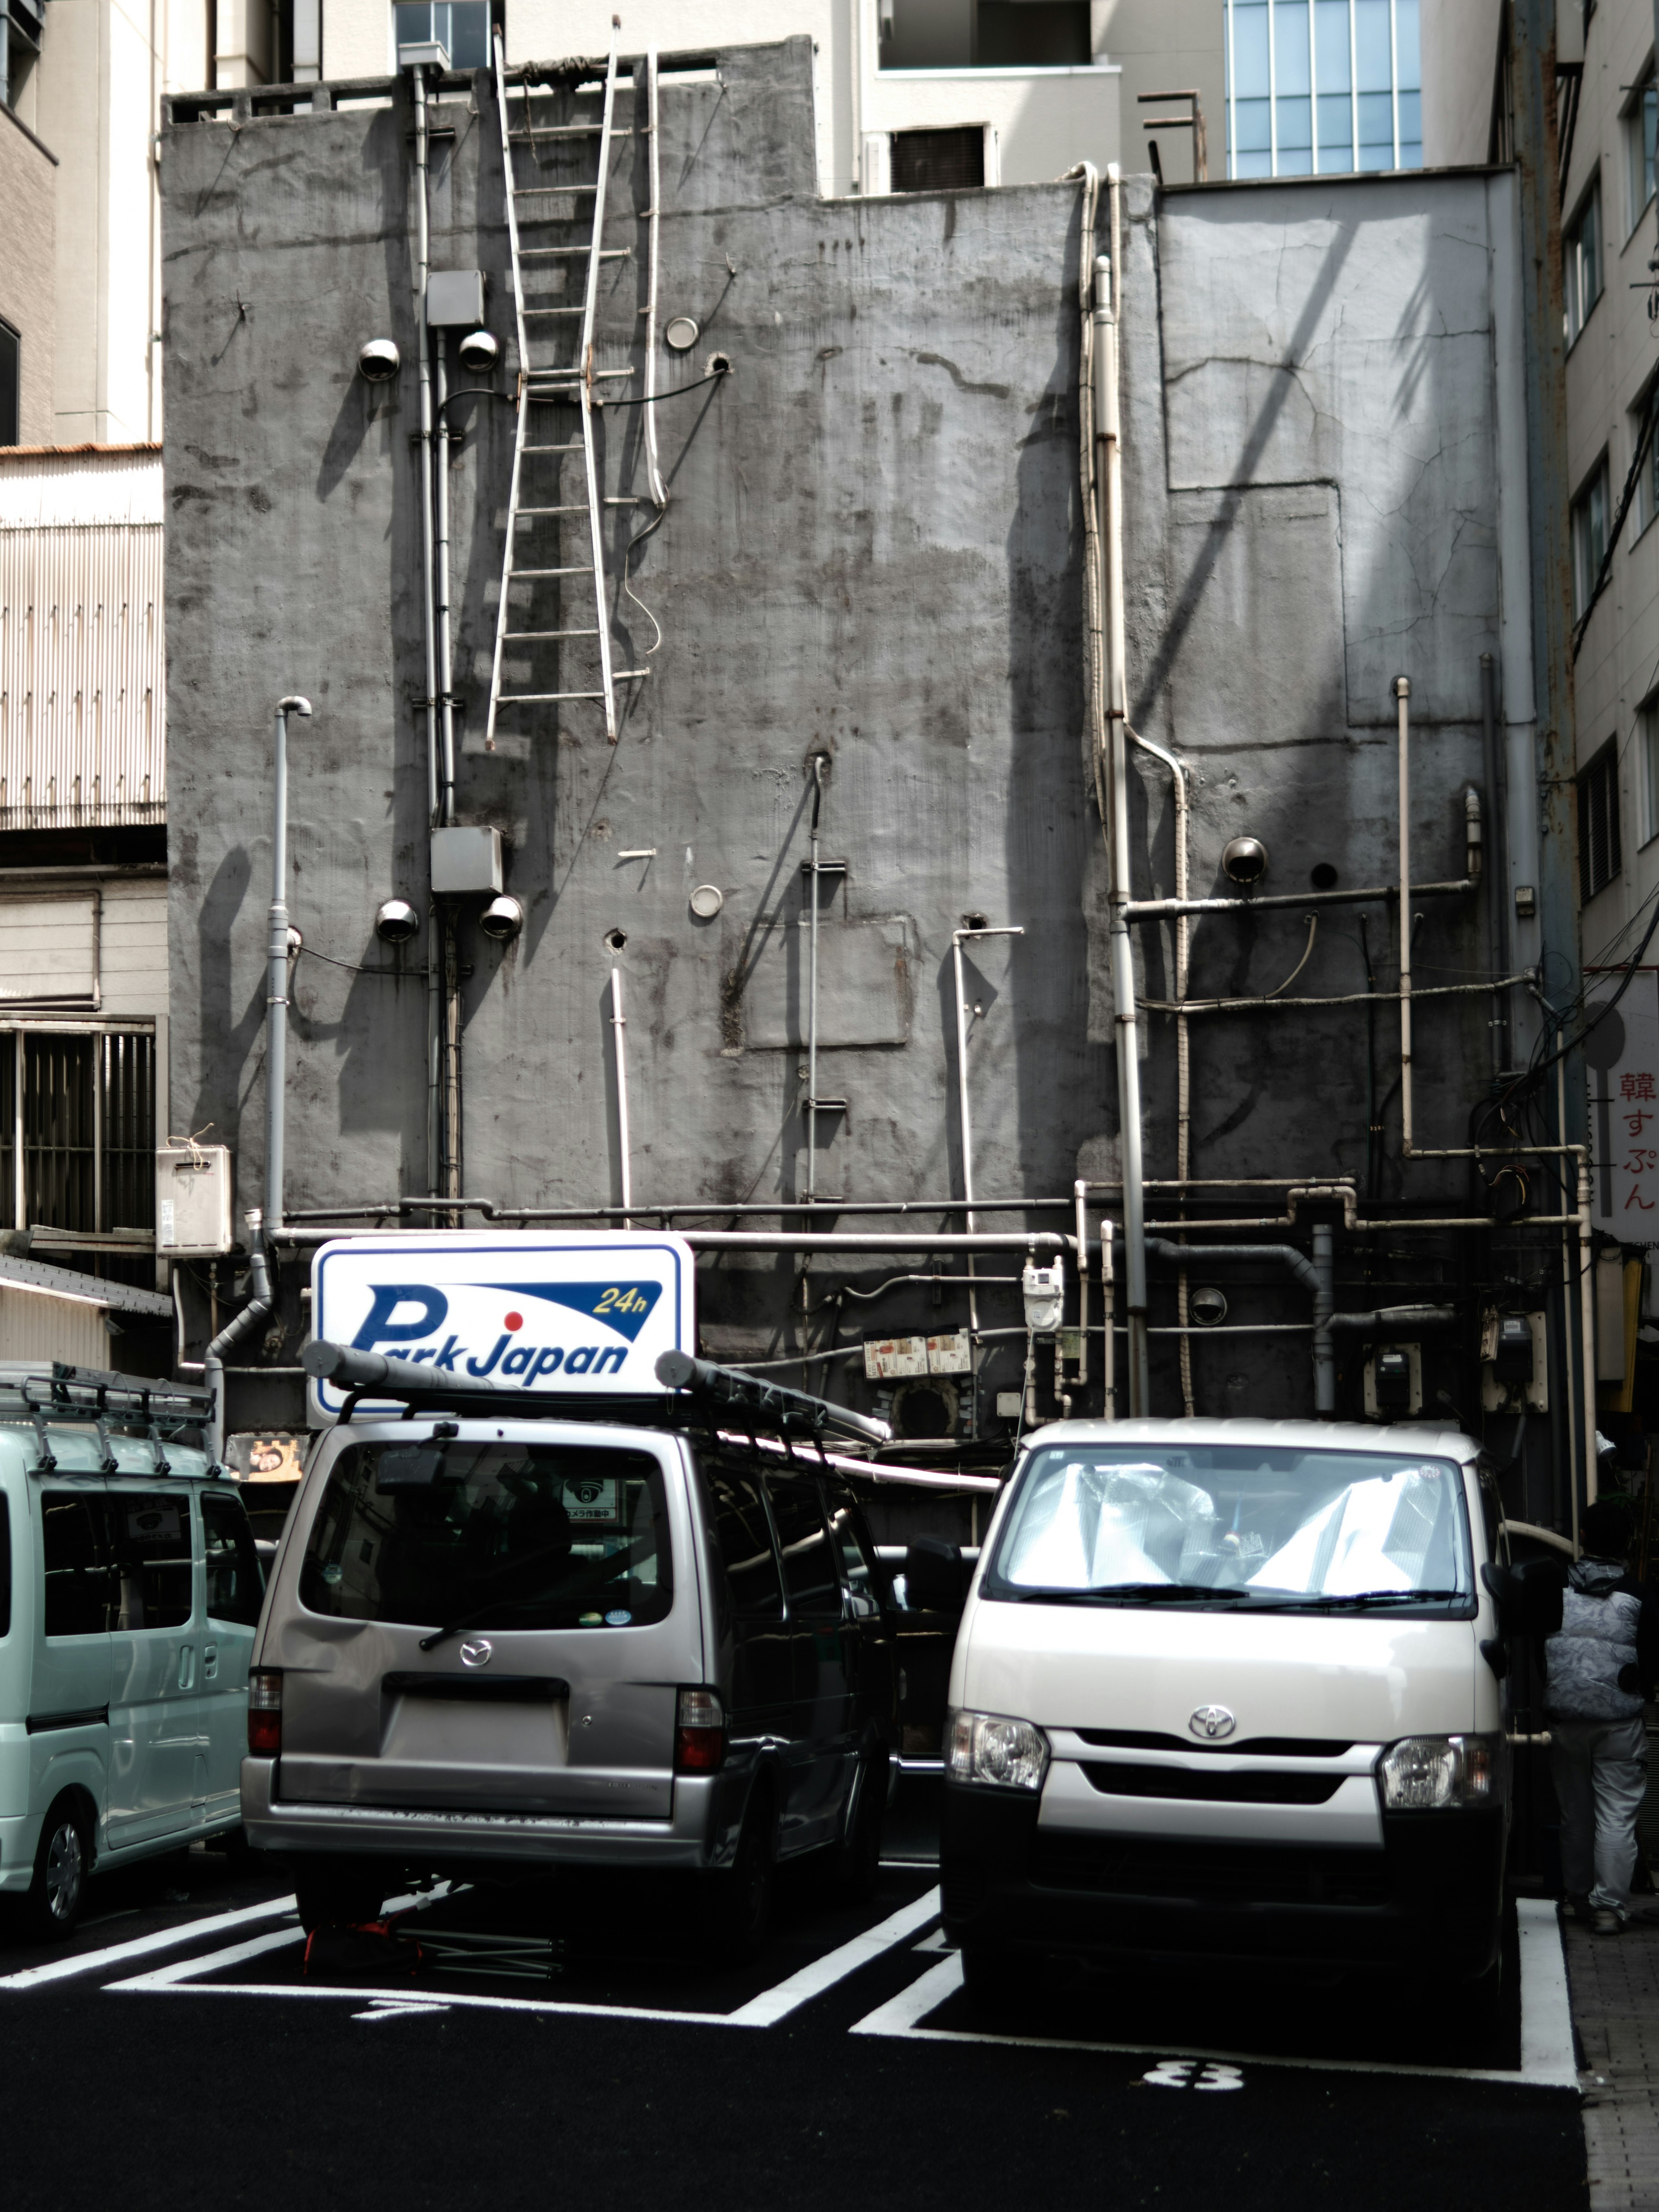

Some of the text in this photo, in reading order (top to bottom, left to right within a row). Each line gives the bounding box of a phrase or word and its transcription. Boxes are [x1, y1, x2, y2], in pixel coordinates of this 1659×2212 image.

[1619, 1072, 1656, 1210] 韓すぷん
[593, 1288, 647, 1313] 24h
[466, 1334, 628, 1387] Japan
